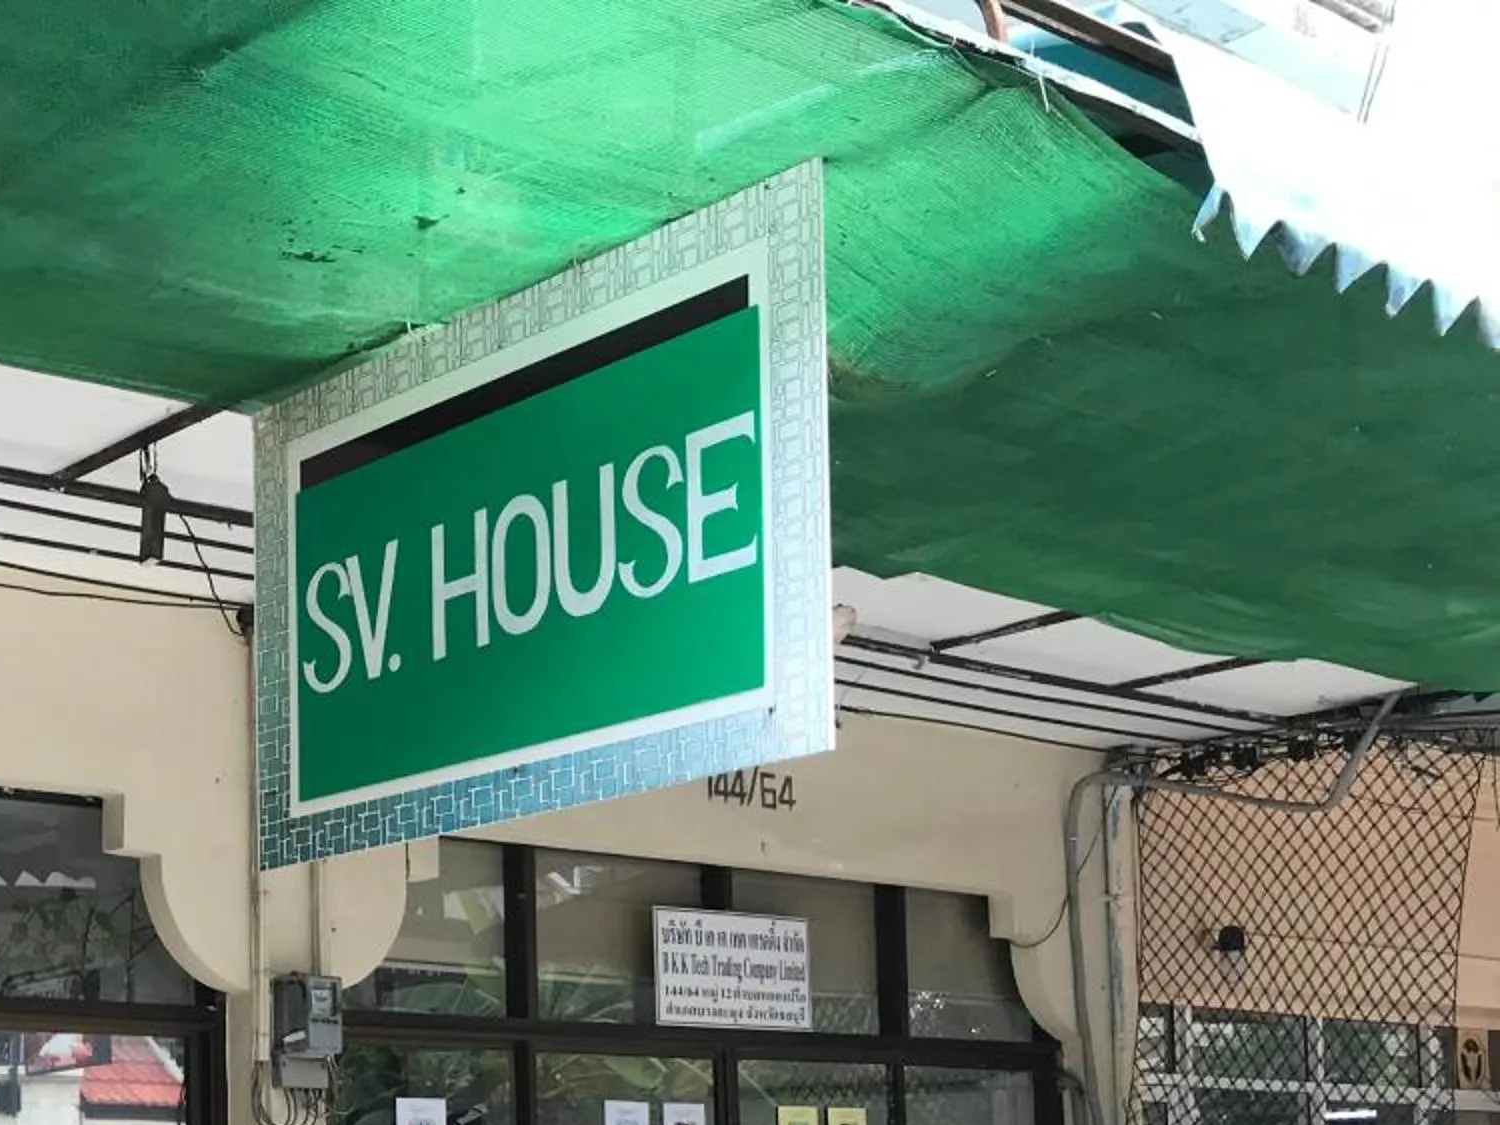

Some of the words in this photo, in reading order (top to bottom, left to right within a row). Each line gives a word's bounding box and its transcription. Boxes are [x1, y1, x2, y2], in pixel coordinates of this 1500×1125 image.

[303, 539, 401, 693] SV.
[431, 410, 758, 661] HOUSE
[707, 765, 797, 812] 144/64
[711, 954, 743, 983] Trading
[743, 957, 777, 985] Company
